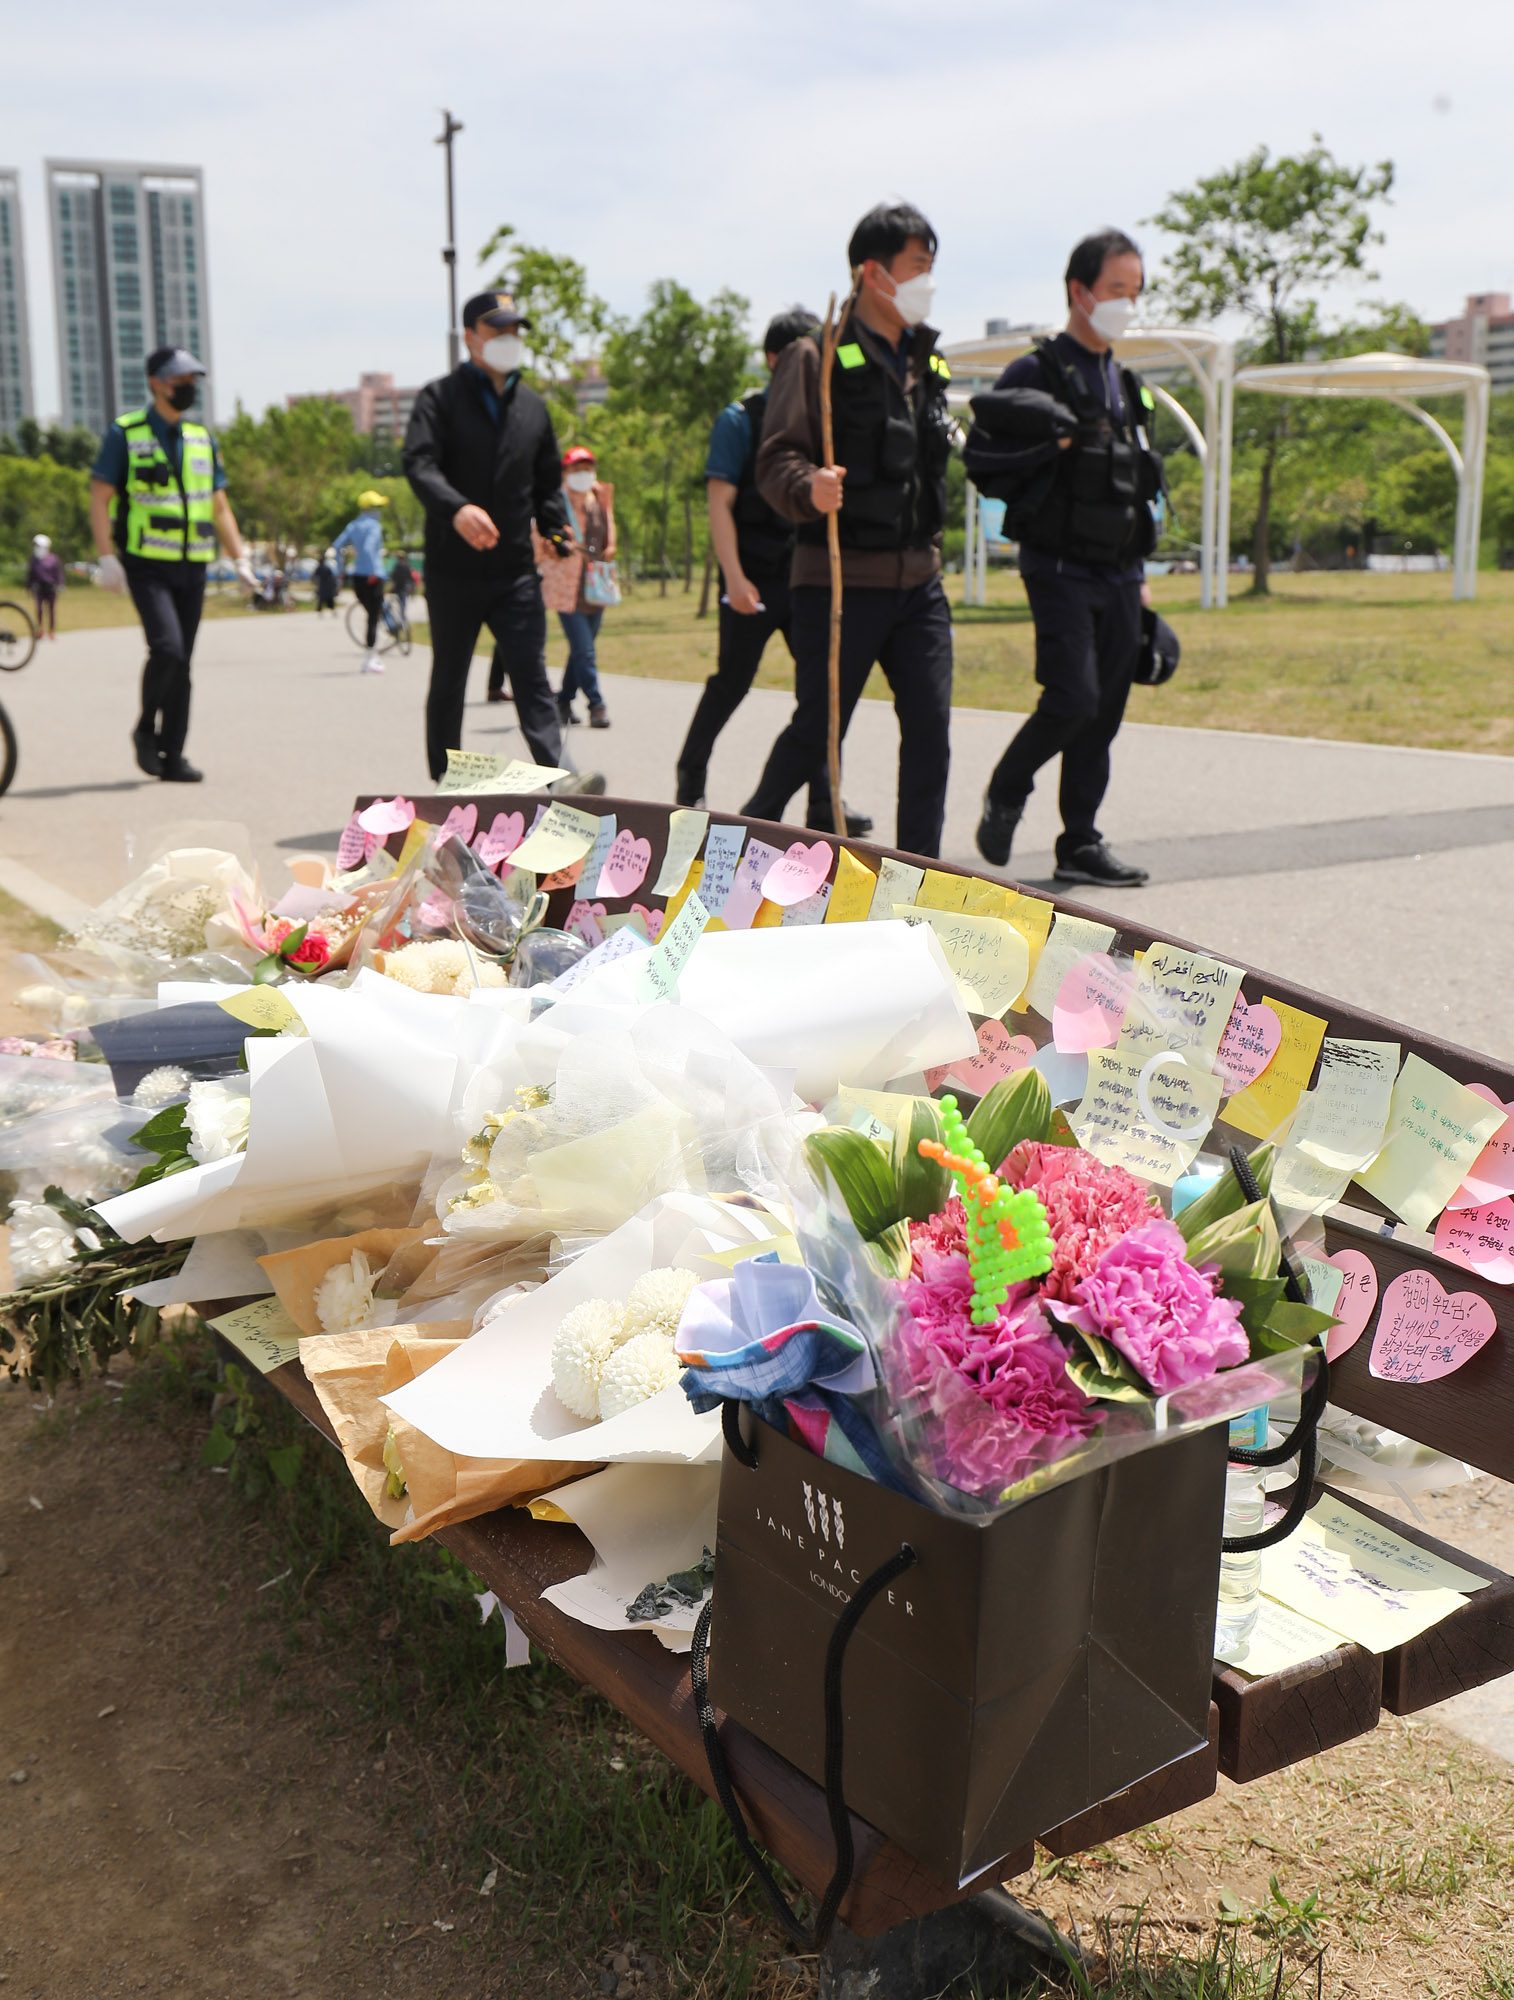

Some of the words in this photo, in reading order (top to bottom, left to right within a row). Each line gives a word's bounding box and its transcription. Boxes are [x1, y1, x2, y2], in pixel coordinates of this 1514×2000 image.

[1486, 1212, 1510, 1231] 손정민
[1449, 1229, 1474, 1240] 에게
[1343, 1272, 1354, 1290] 더
[1360, 1275, 1371, 1292] 큰
[1402, 1274, 1430, 1291] 21.5.9
[1403, 1286, 1429, 1313] 정민이
[1432, 1294, 1478, 1321] 부모님!
[1455, 1328, 1485, 1347] 진실을
[1429, 1344, 1456, 1363] 응원
[755, 1507, 805, 1549] JANE
[818, 1547, 914, 1616] PACER
